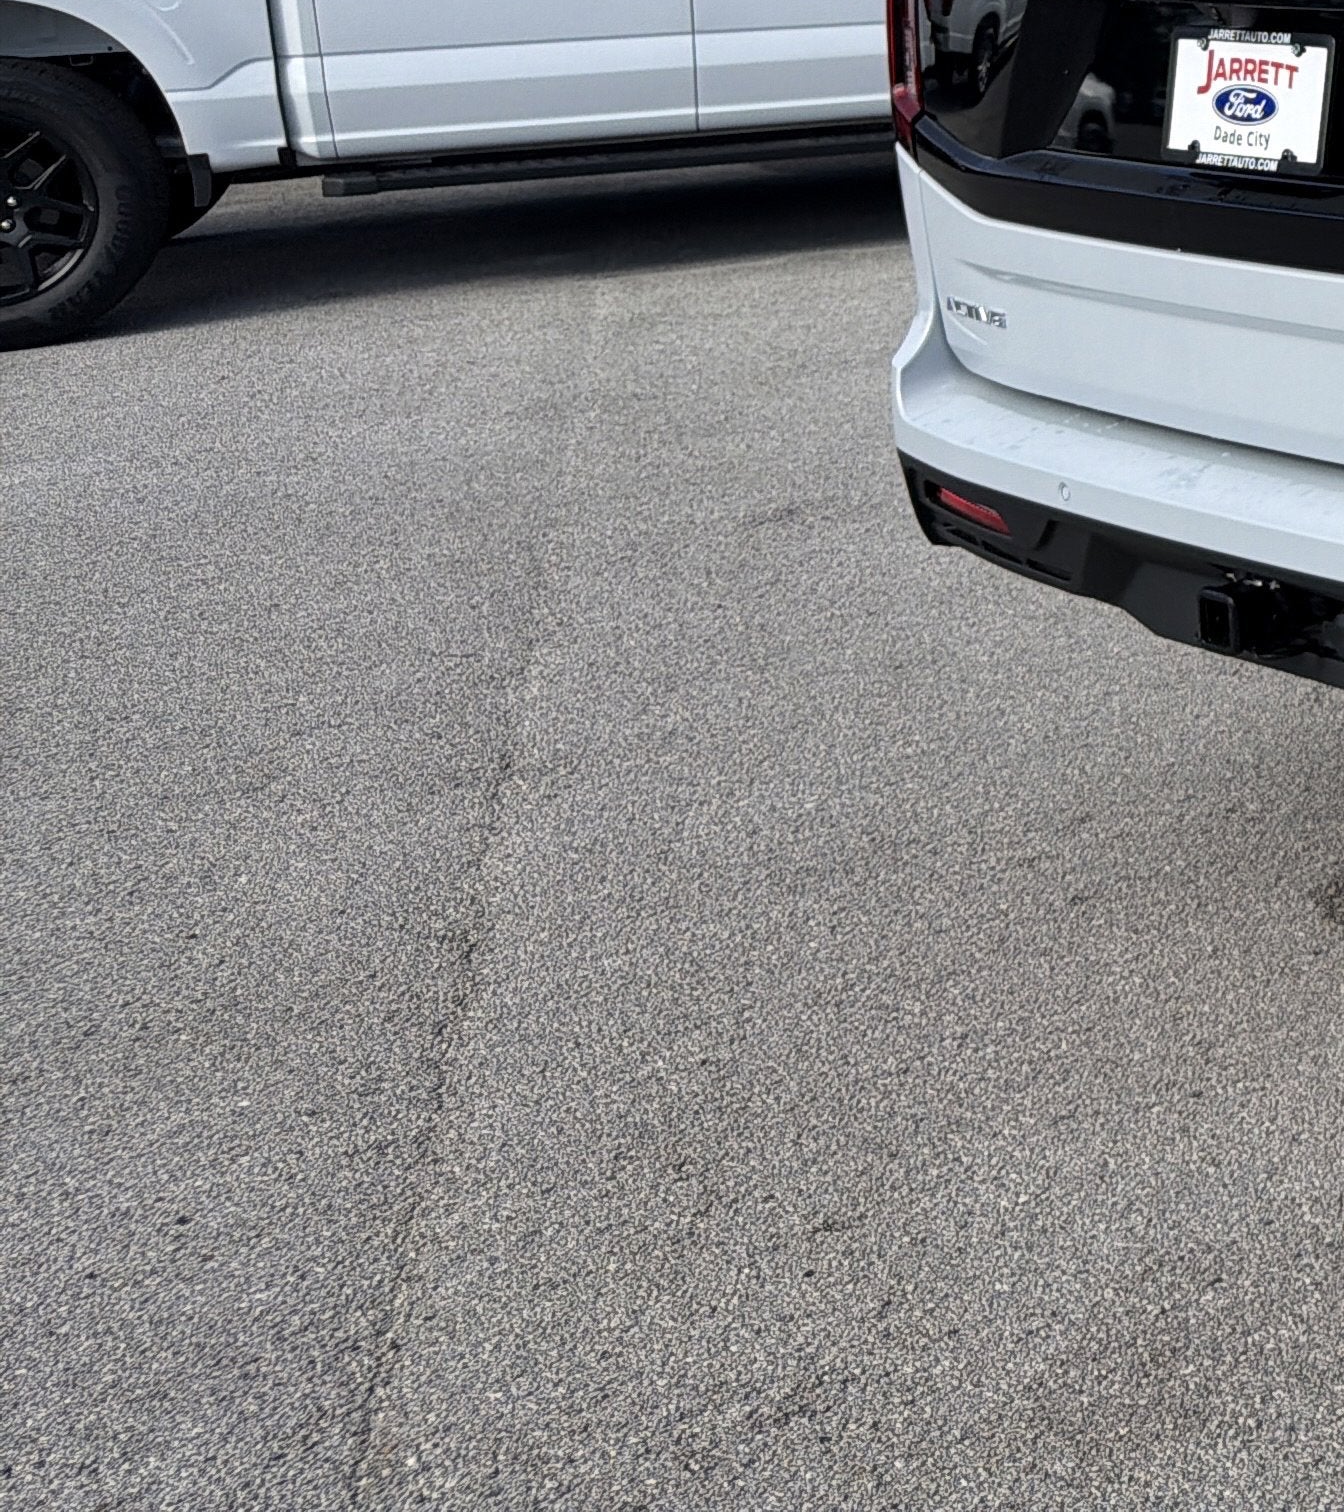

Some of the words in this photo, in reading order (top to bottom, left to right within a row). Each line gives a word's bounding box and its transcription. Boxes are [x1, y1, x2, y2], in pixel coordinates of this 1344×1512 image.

[1208, 29, 1292, 43] JARRETTAUTO.COM
[1197, 49, 1299, 95] JARRETT
[1223, 89, 1267, 119] Ford
[1214, 125, 1243, 146] Dade
[1247, 131, 1271, 151] City
[1196, 152, 1279, 172] JARRETTAUTO.COM
